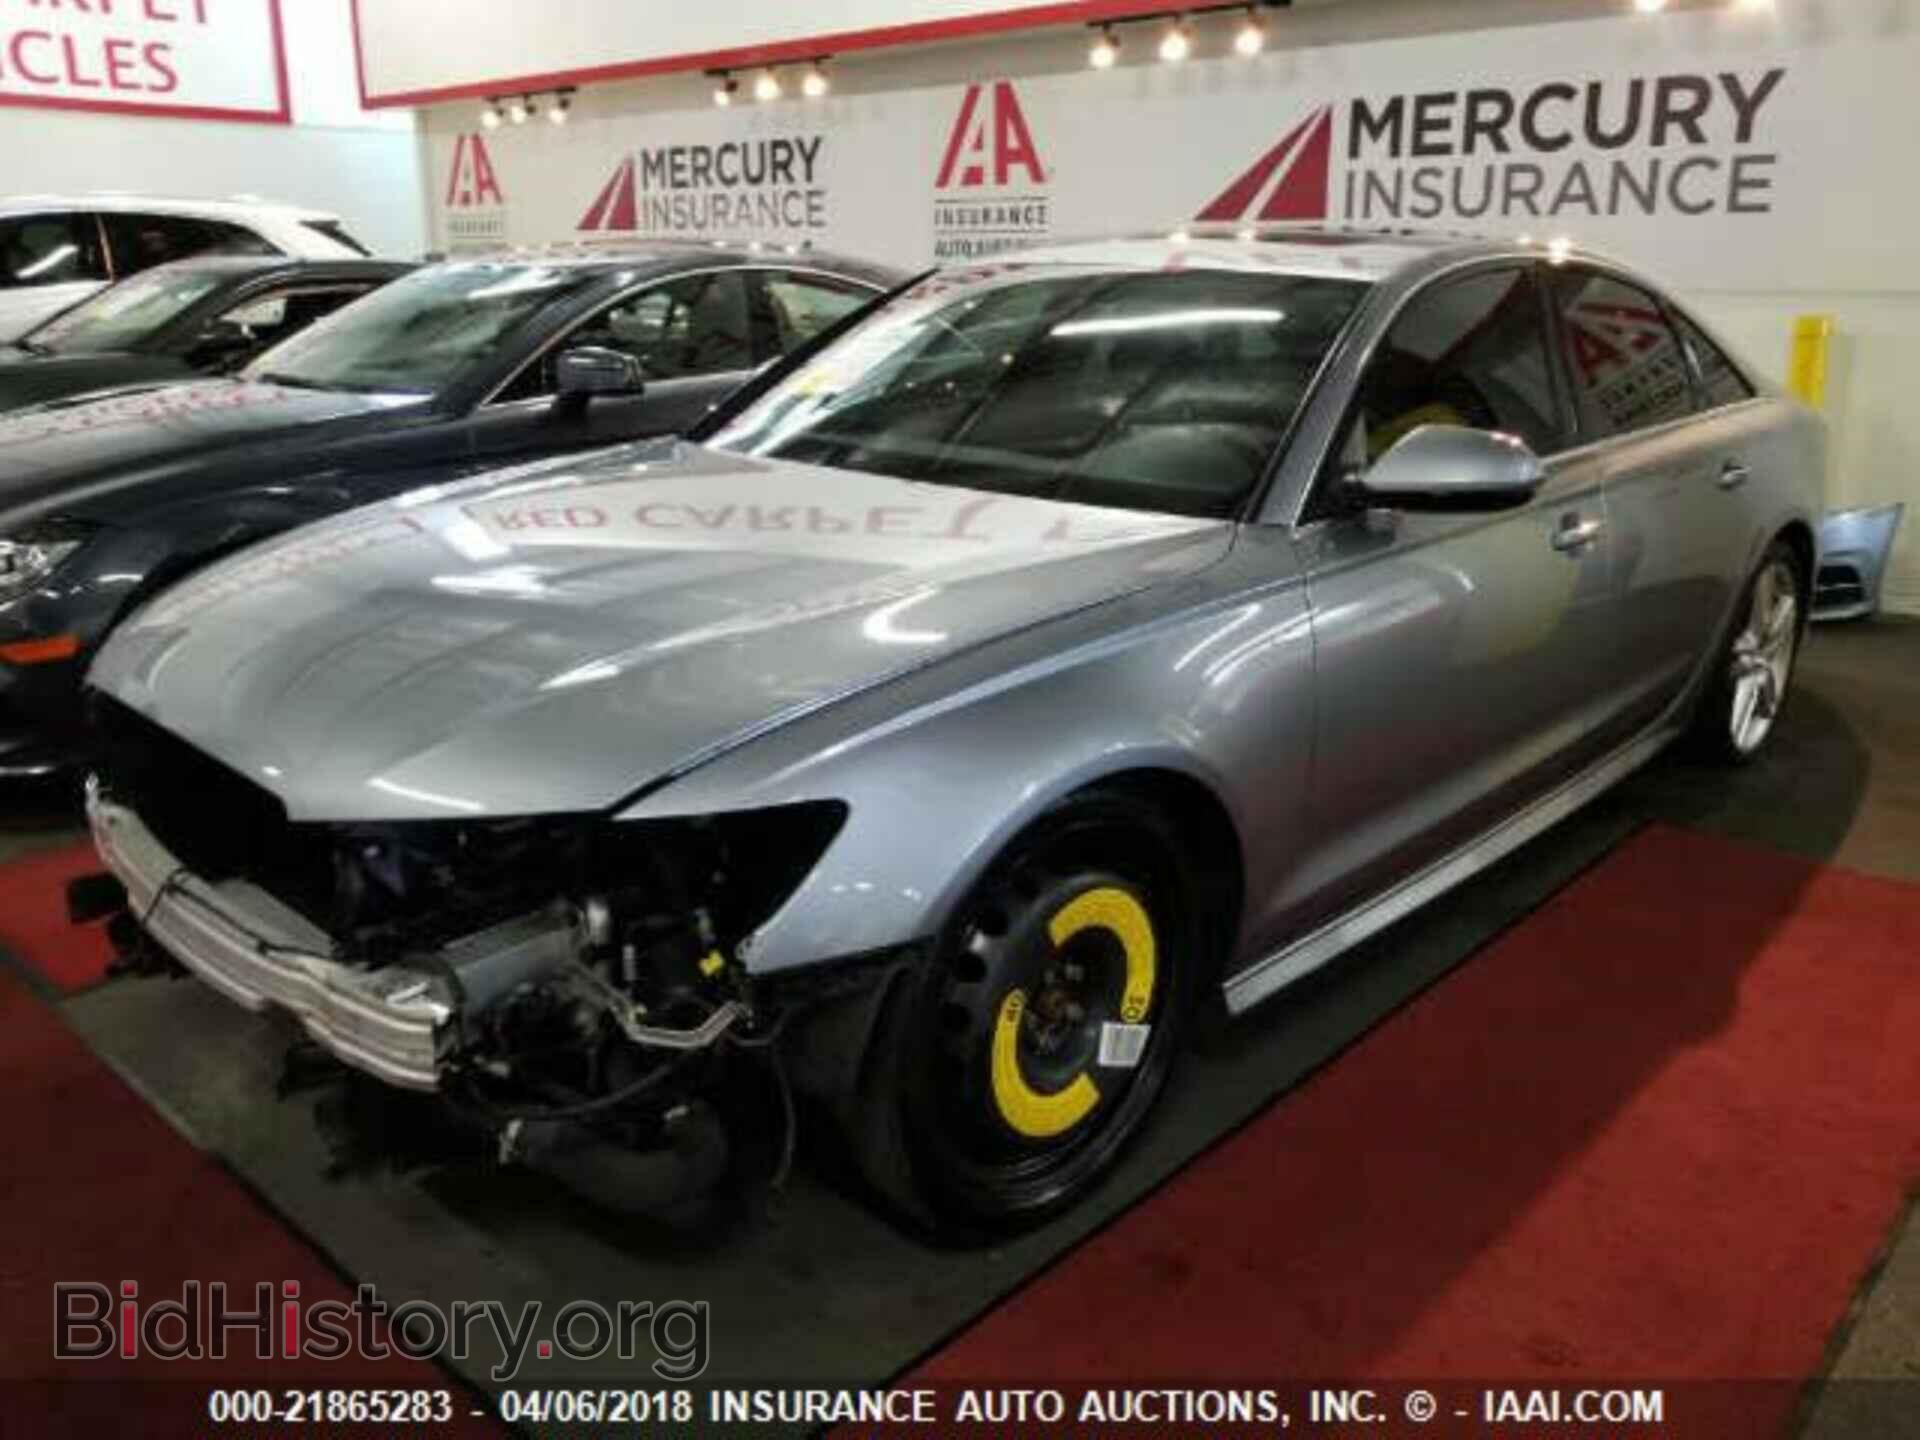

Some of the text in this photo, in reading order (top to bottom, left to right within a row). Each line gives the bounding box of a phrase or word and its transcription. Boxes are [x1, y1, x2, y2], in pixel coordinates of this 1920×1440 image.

[0, 30, 178, 93] CLES
[1347, 68, 1786, 160] MERCURY
[640, 134, 823, 189] MERCURY
[1343, 153, 1778, 220] INSURANCE
[643, 189, 827, 232] INSURANCE
[934, 204, 1048, 226] INSURANCE
